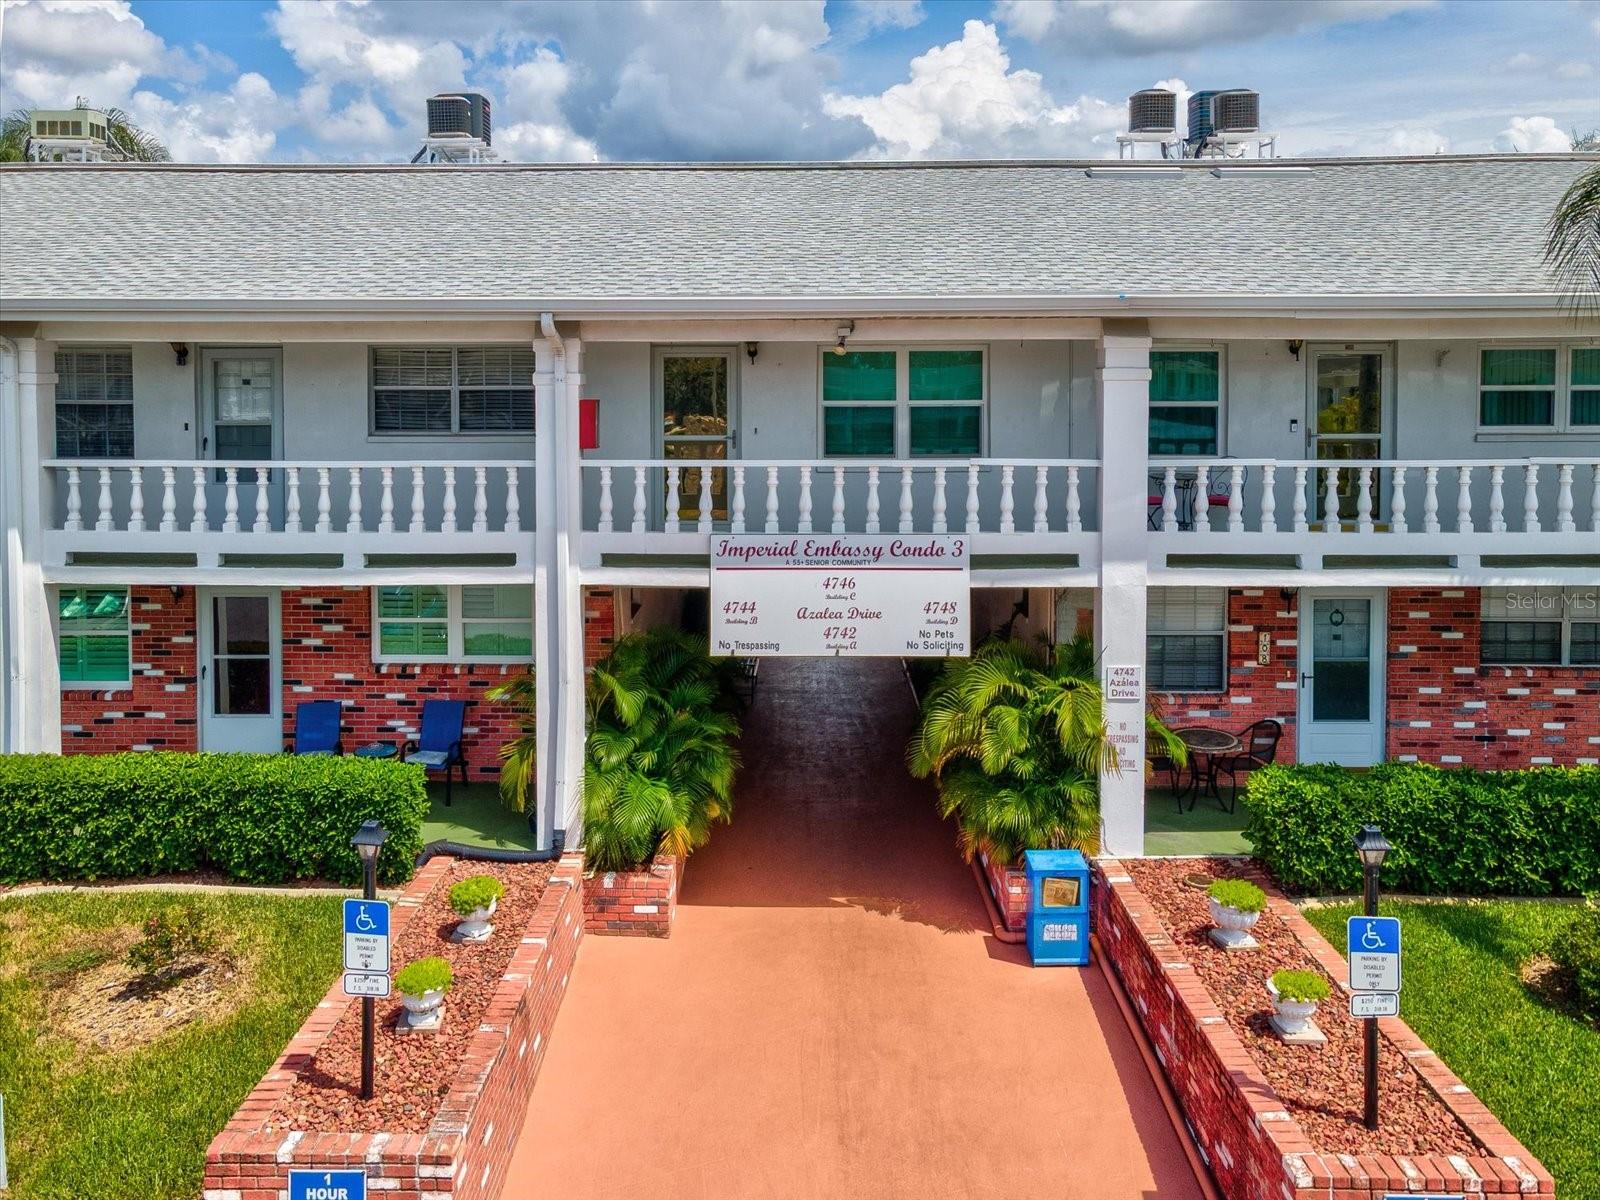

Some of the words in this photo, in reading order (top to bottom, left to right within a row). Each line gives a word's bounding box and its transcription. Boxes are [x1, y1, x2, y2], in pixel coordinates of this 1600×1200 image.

[716, 539, 798, 562] Imperial
[804, 539, 884, 562] Embassy
[890, 540, 945, 557] Condo
[952, 540, 963, 557] 3
[822, 577, 856, 590] 4746
[849, 592, 857, 601] C
[723, 601, 757, 614] 4744
[796, 606, 844, 620] Azalea
[847, 607, 883, 620] Drive
[923, 601, 957, 614] 4748
[749, 616, 758, 625] B
[925, 618, 949, 626] Building
[949, 616, 958, 625] D
[823, 626, 857, 639] 4742
[919, 630, 932, 639] No
[935, 630, 954, 639] Pets
[719, 640, 731, 650] No
[734, 641, 780, 652] Trespassing
[849, 641, 857, 650] A
[906, 640, 920, 650] No
[923, 640, 964, 652] Soliciting
[1114, 668, 1135, 676] 4742
[1109, 679, 1139, 687] Azalea
[1120, 722, 1126, 731] NO
[324, 1173, 331, 1186] 1
[306, 1188, 348, 1200] HOUR
